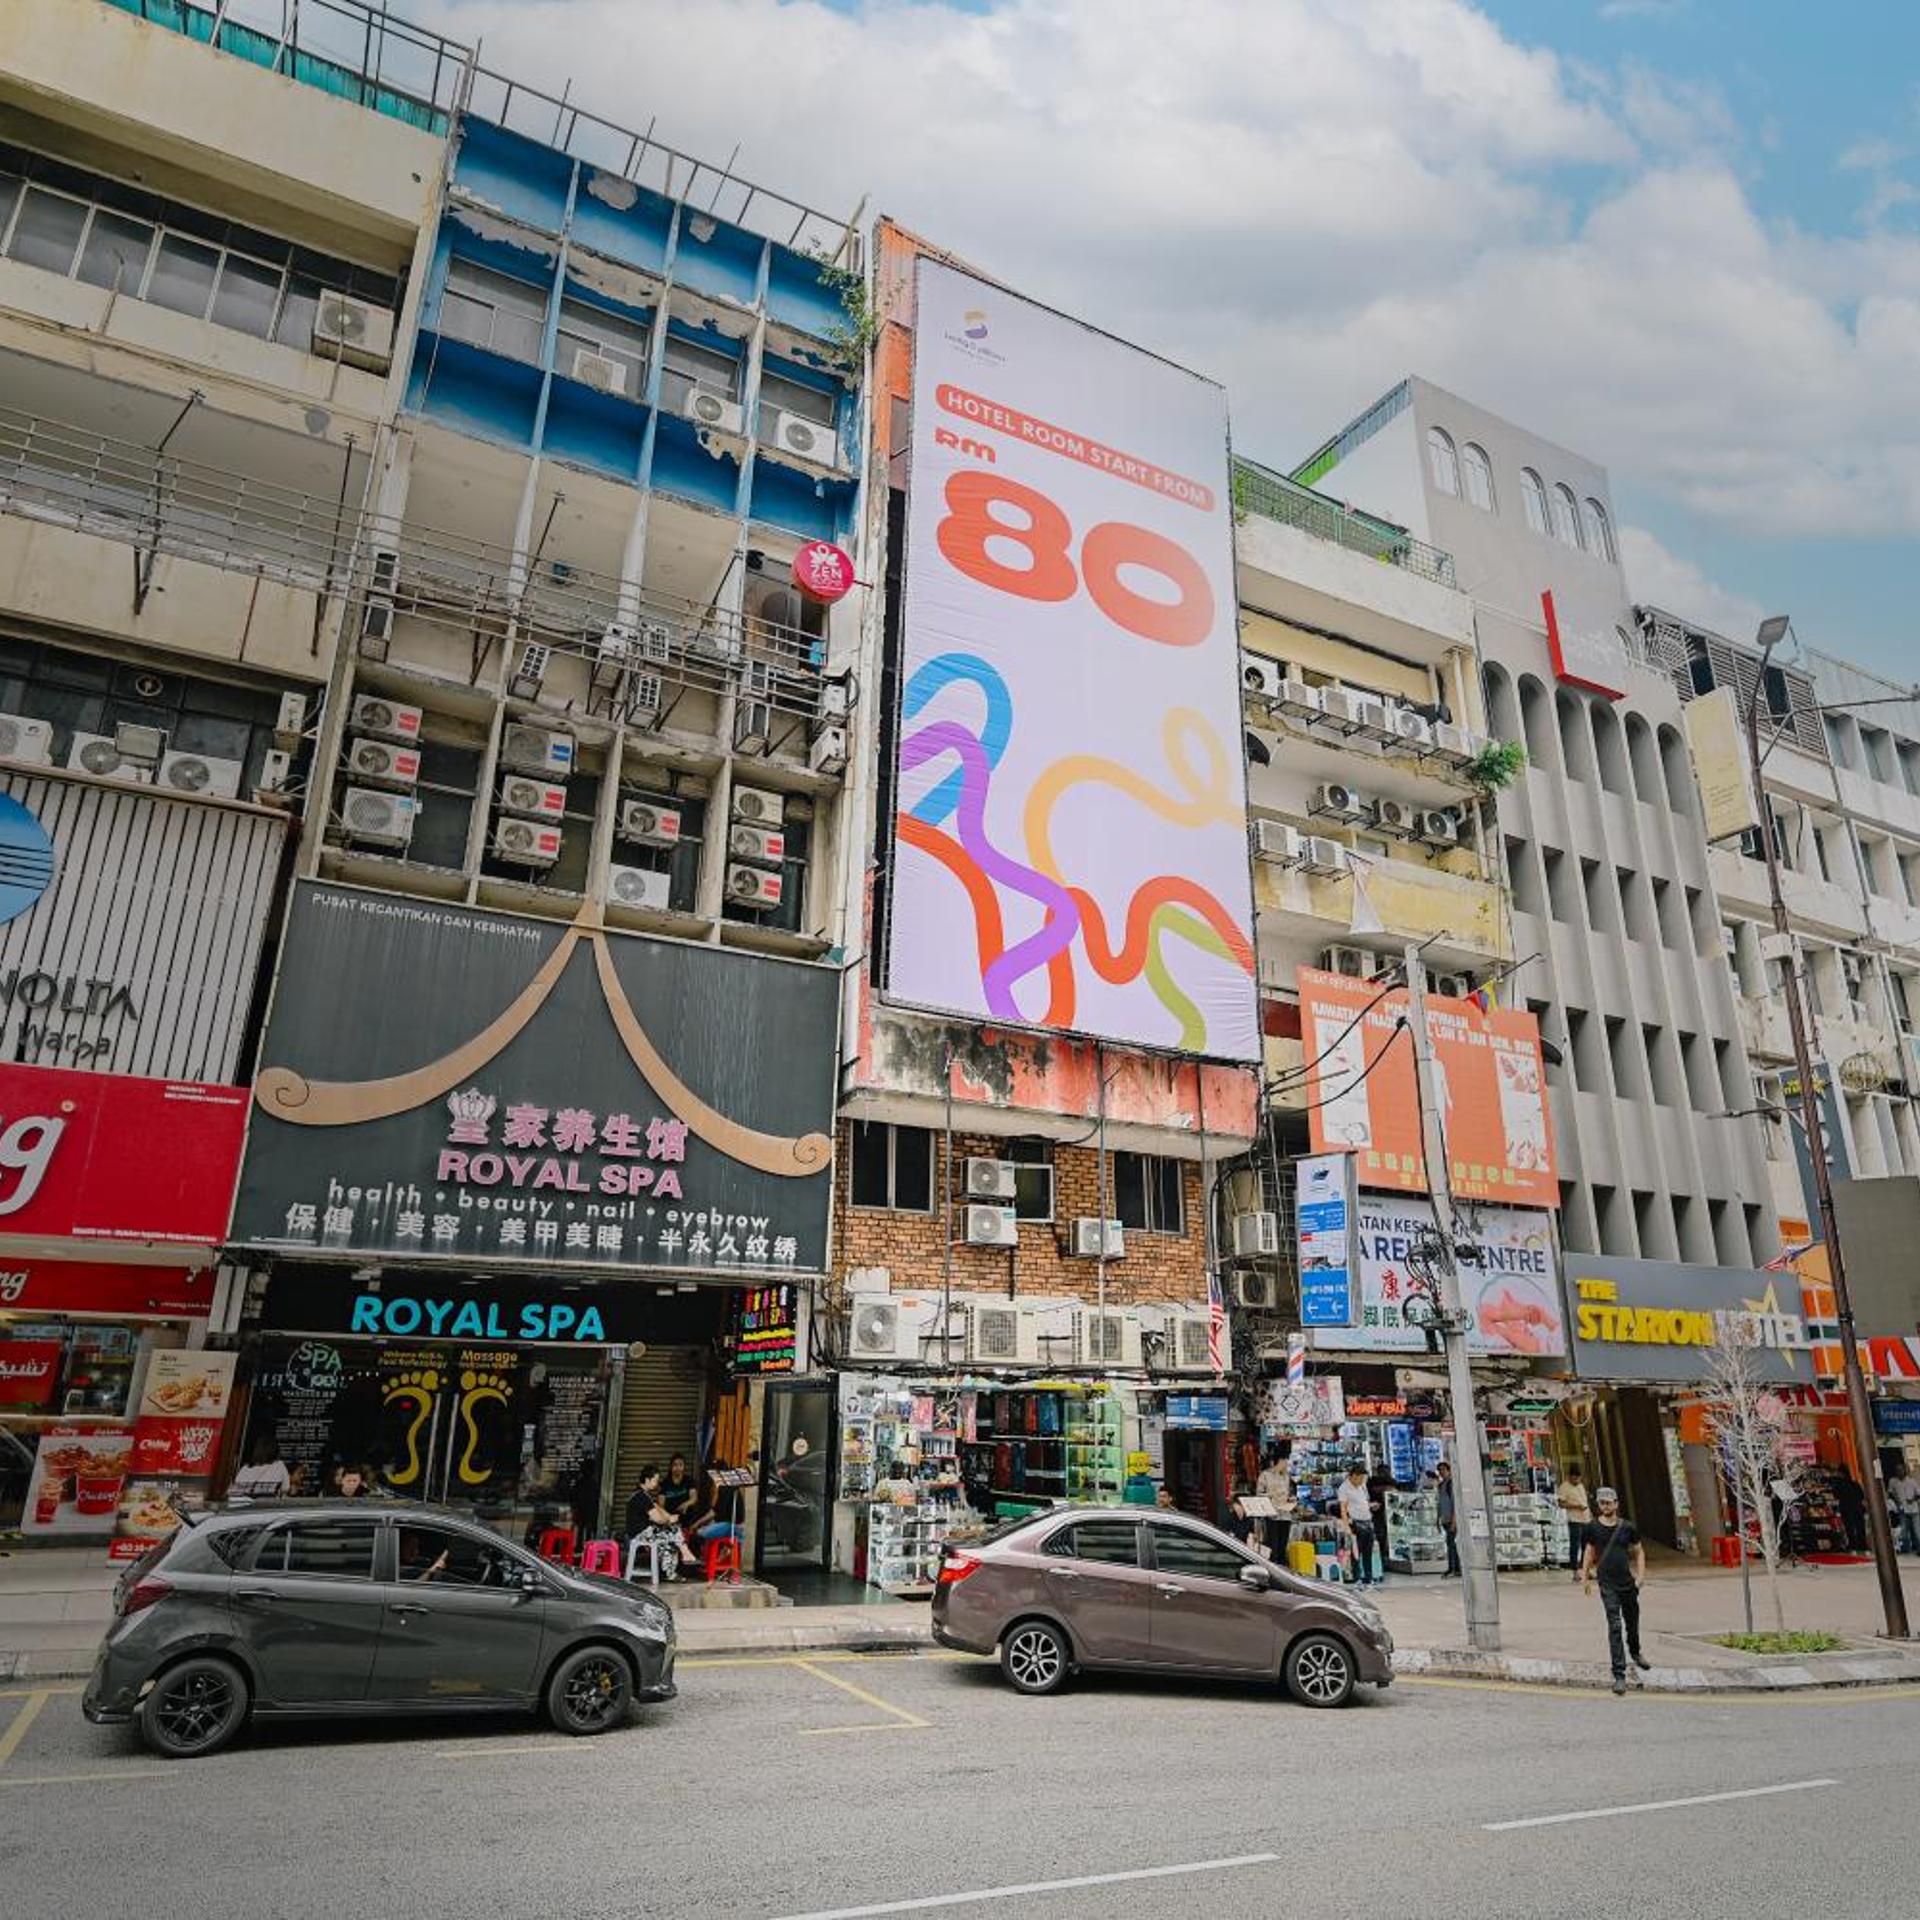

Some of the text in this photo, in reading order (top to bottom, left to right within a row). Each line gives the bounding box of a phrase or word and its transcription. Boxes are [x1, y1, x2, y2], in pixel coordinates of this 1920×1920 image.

[947, 391, 1206, 502] HOTEL ROOM START FROM
[811, 563, 843, 580] ZEN
[936, 469, 1215, 647] 80
[312, 892, 542, 941] PUSAT KECANTIKAN DAN KESIHATAN
[437, 1149, 683, 1200] ROYAL SPA
[283, 1202, 355, 1234] 保健
[396, 1210, 460, 1241] 美容
[328, 1177, 770, 1229] health beauty nail eyebrow
[1576, 1279, 1618, 1300] THE
[351, 1296, 606, 1341] ROYAL SPA
[298, 1341, 343, 1371] SPA
[459, 1350, 519, 1363] Massage
